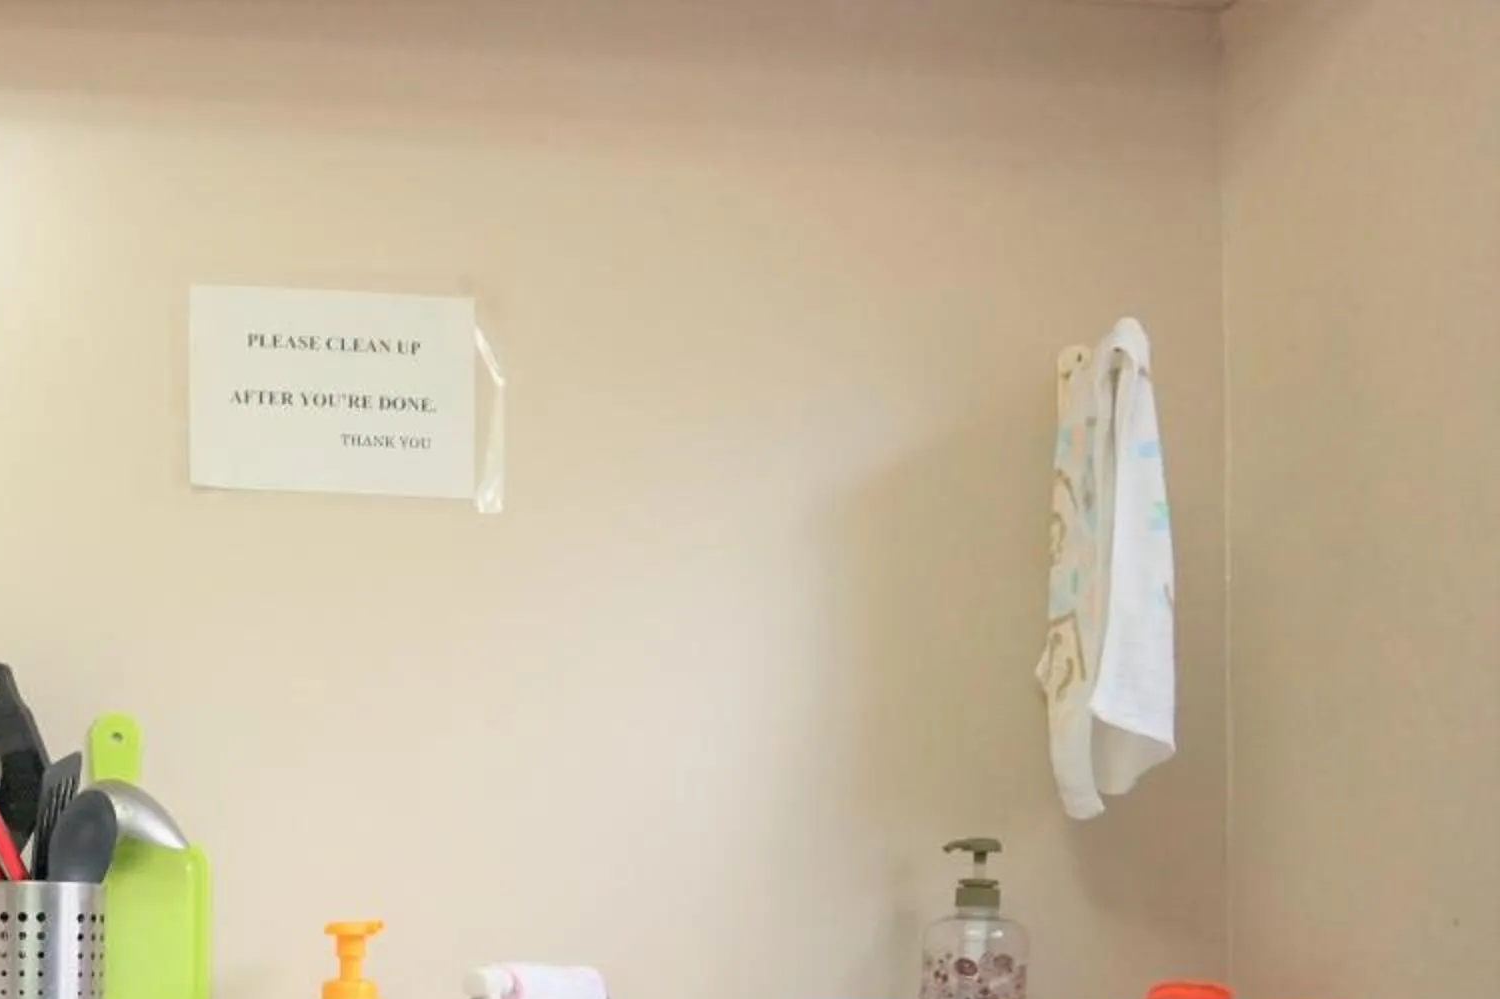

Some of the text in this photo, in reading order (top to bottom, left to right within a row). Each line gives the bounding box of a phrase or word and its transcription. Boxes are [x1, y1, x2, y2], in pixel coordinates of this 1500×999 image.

[247, 332, 421, 356] PLEASE CLEAN UP
[230, 389, 437, 413] AFTER YOU'RE DONE.
[340, 432, 432, 450] THANK YOU
